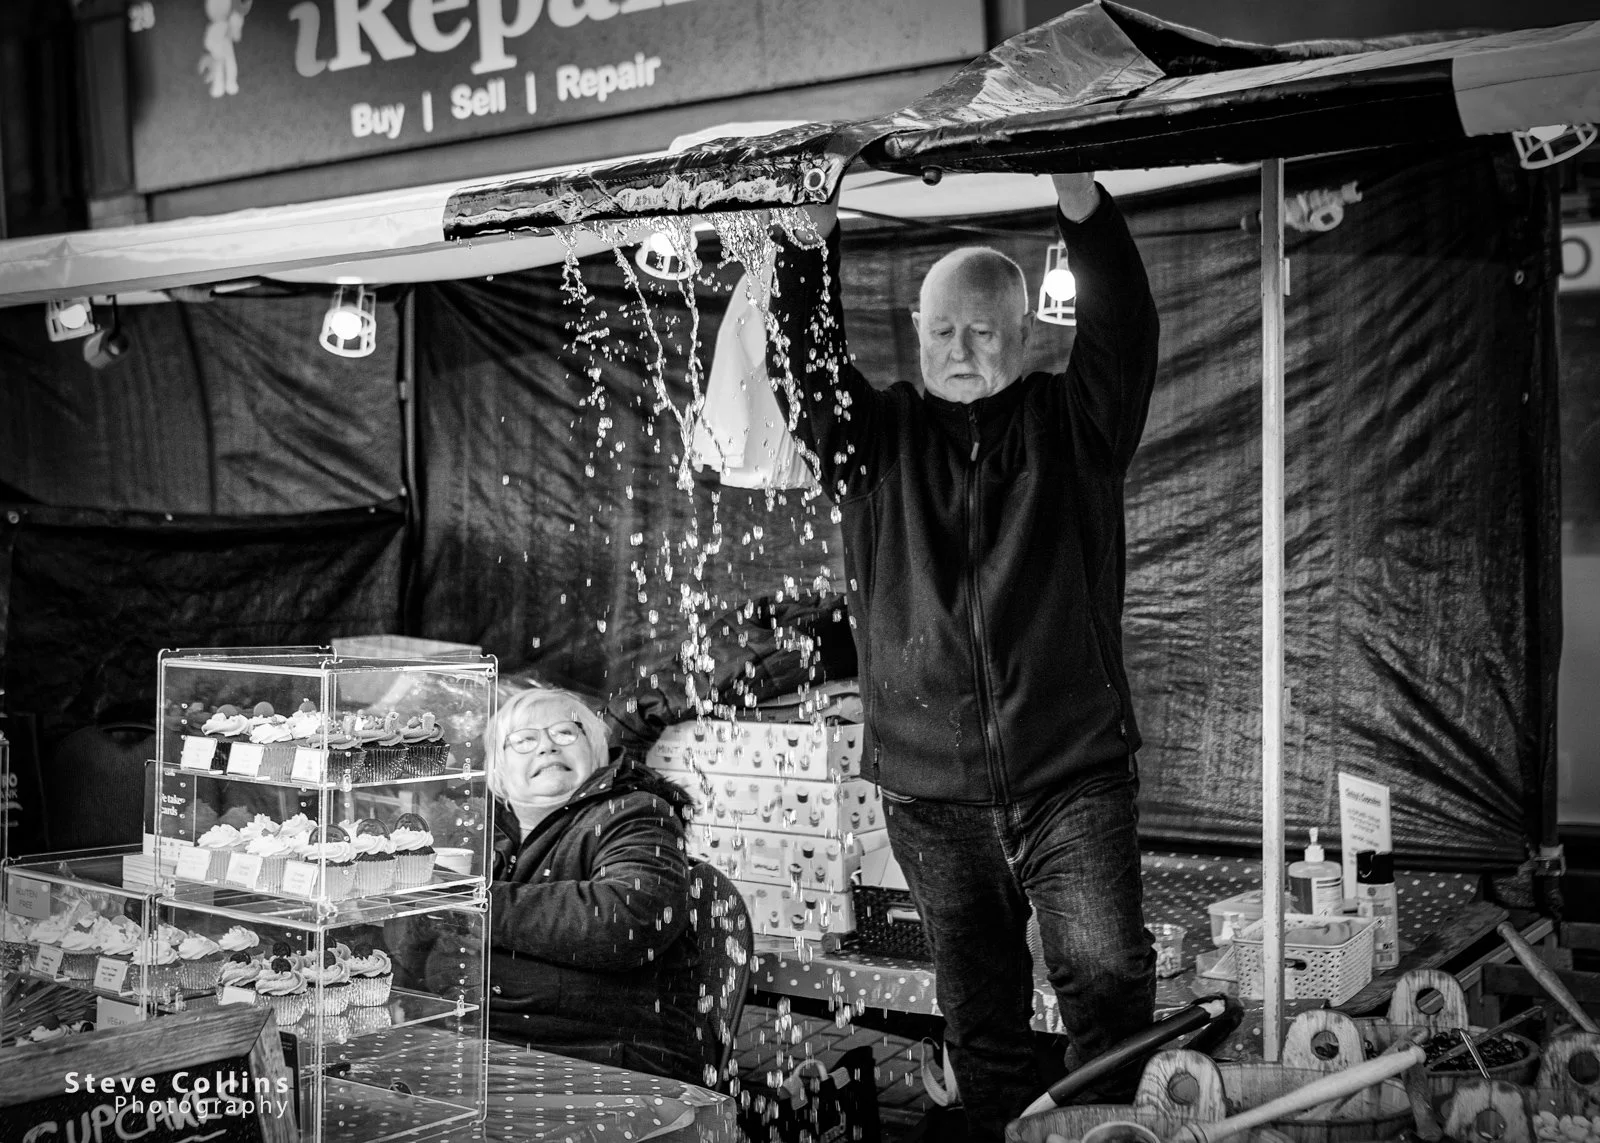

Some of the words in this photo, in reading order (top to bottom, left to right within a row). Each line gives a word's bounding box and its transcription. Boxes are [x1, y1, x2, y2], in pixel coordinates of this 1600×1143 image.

[288, 0, 692, 77] iRep
[351, 102, 405, 139] Buy
[450, 77, 507, 119] Sell
[556, 52, 661, 102] Repair
